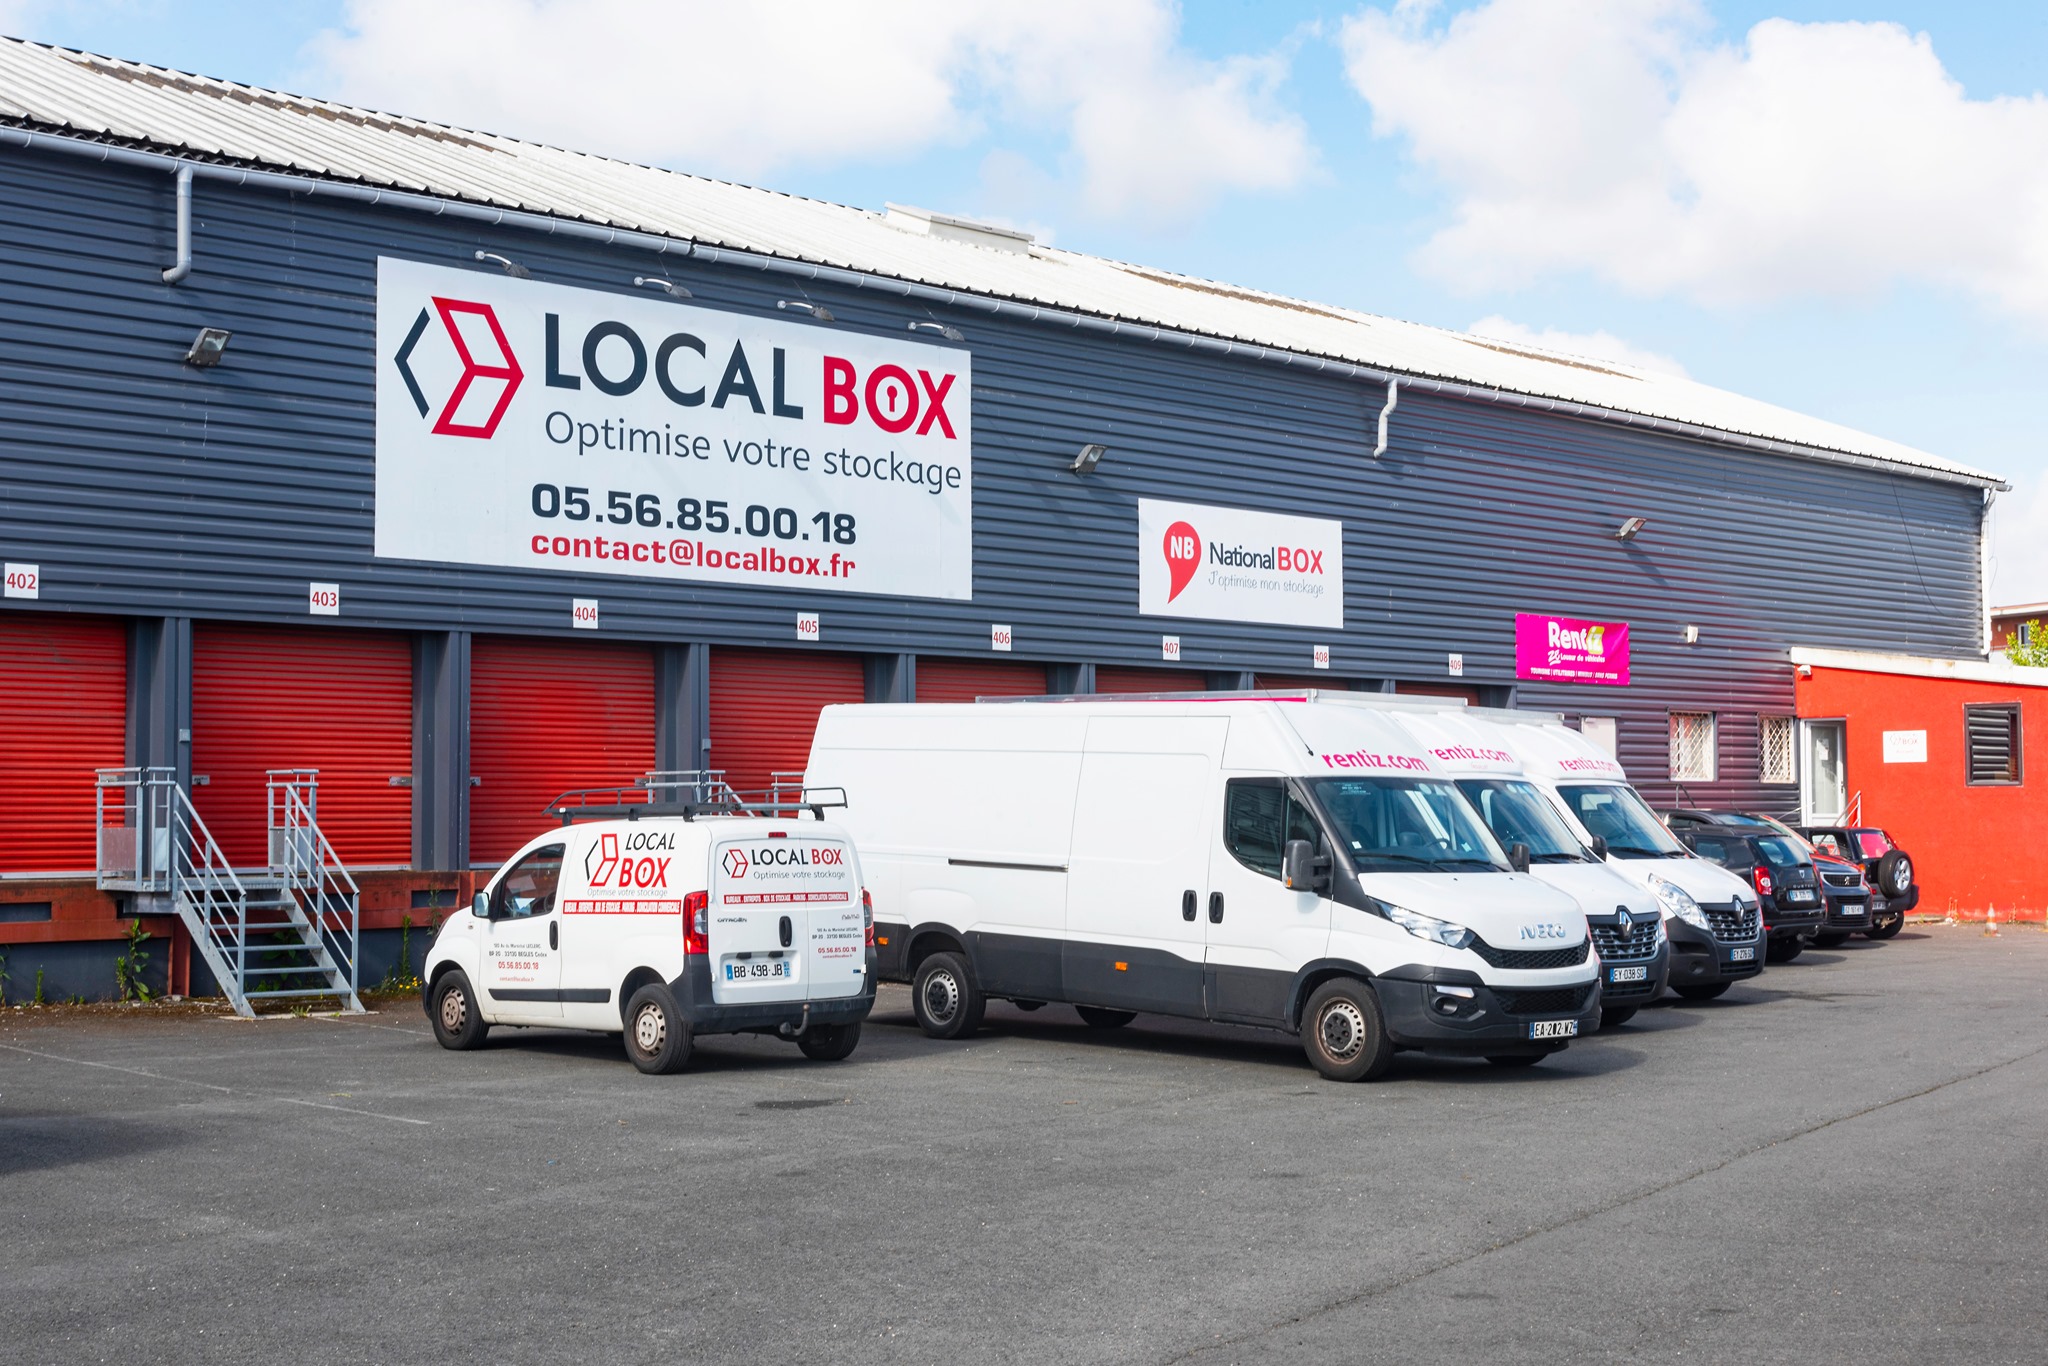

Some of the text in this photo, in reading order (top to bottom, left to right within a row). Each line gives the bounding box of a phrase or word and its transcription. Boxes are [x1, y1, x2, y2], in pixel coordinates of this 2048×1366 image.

[545, 313, 957, 440] LOCAL BOX
[545, 411, 962, 495] Optimise votre stockage
[531, 483, 857, 545] 05.56.85.00.18
[1170, 535, 1195, 560] NB
[531, 534, 856, 579] contact@localbox.fr
[7, 572, 37, 591] 402
[1260, 580, 1280, 590] mon
[1284, 579, 1324, 598] stockage
[311, 590, 337, 607] 403
[574, 606, 597, 622] 404
[799, 620, 818, 634] 405
[993, 632, 1010, 645] 406
[1548, 621, 1602, 652] Rentiz
[1164, 642, 1179, 654] 407
[1314, 651, 1328, 664] 408
[1449, 659, 1462, 672] 409
[1321, 749, 1430, 772] rentiz.com
[1558, 757, 1620, 773] rentiz.com
[625, 832, 675, 850] LOCAL
[752, 848, 843, 865] LOCAL BOX
[618, 857, 672, 888] BOX
[754, 871, 790, 880] Optimise
[814, 870, 846, 880] stockage
[587, 888, 616, 898] Optimise
[637, 888, 668, 897] stockage
[1518, 923, 1566, 940] IVECO
